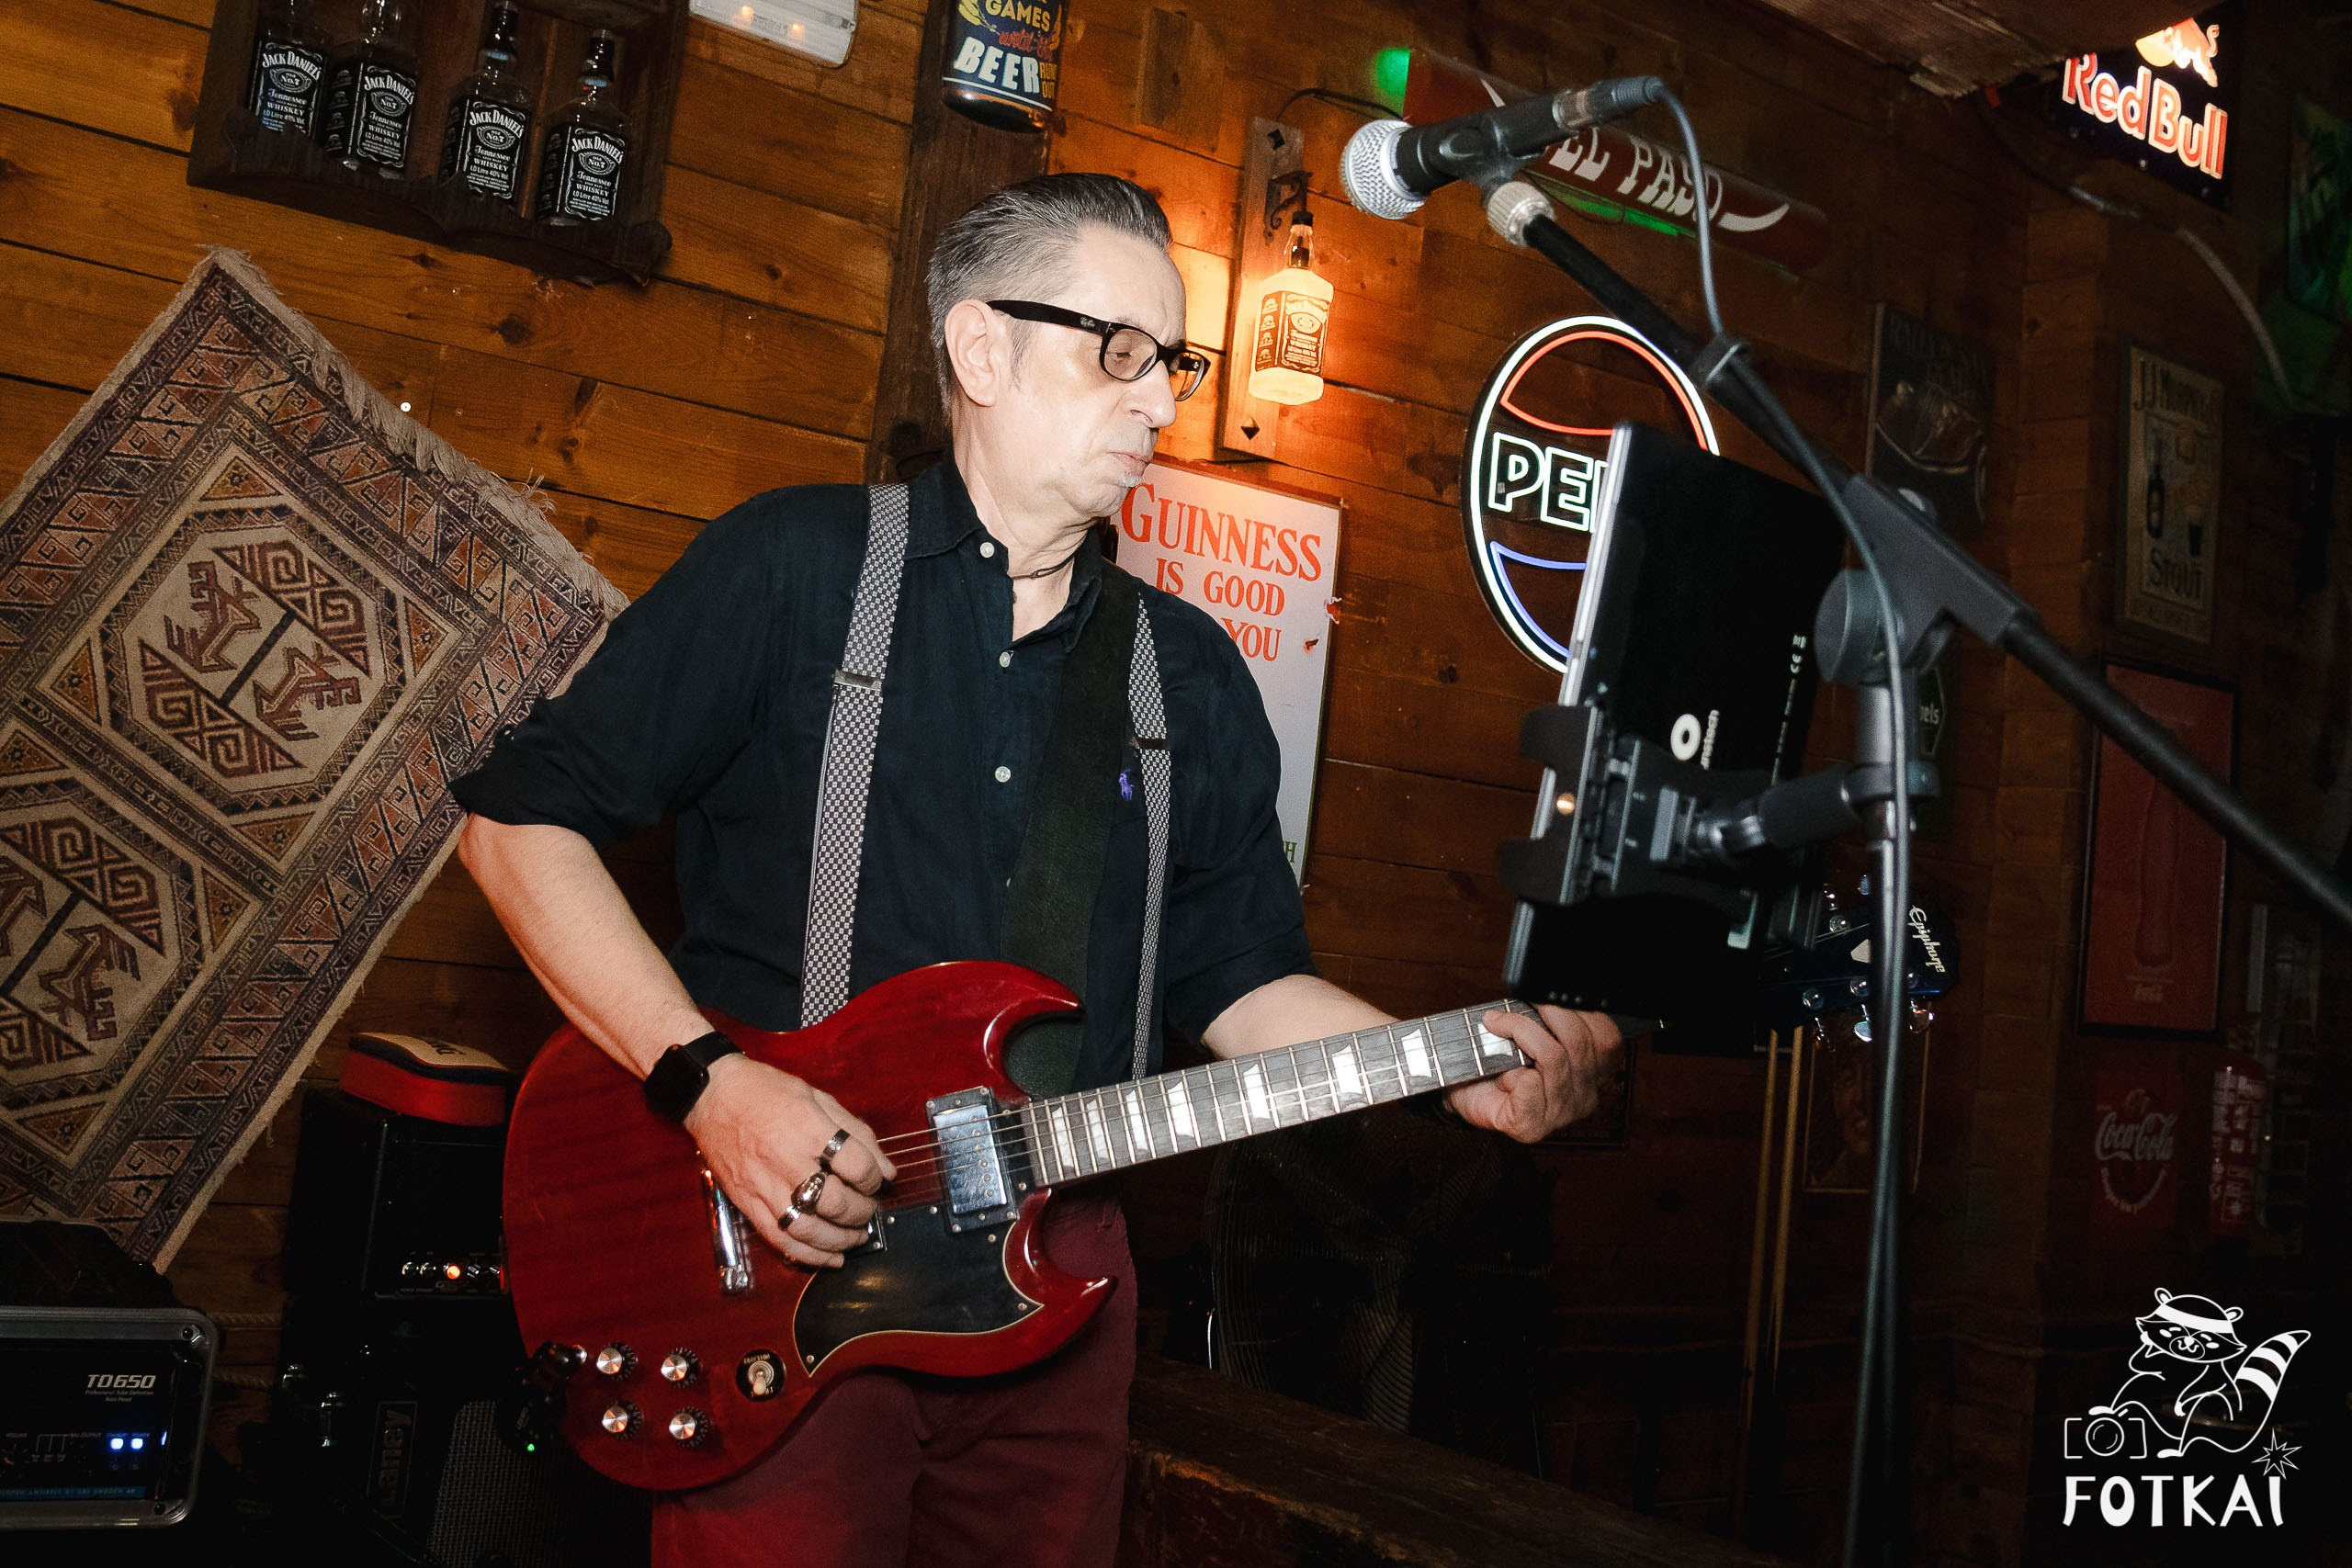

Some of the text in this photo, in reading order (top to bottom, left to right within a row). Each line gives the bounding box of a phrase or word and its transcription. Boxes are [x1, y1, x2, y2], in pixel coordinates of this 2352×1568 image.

[985, 0, 1051, 32] GAMES
[262, 51, 322, 81] JACK DANIEL'S
[954, 37, 1040, 94] BEER
[364, 74, 415, 105] JACK DANIEL'S
[266, 101, 305, 116] WHISKEY
[368, 124, 401, 140] WHISKEY
[469, 109, 525, 139] JACK DANIEL'S
[473, 157, 509, 172] WHISKEY
[475, 144, 511, 162] Tennessee
[571, 135, 625, 164] JACK DANIEL'S
[576, 183, 609, 197] WHISKEY
[577, 170, 612, 186] Tennessee
[1121, 483, 1322, 582] GUINNESS
[1156, 558, 1285, 617] IS GOOD
[1221, 616, 1282, 662] YOU
[1907, 905, 1946, 973] Epiphone
